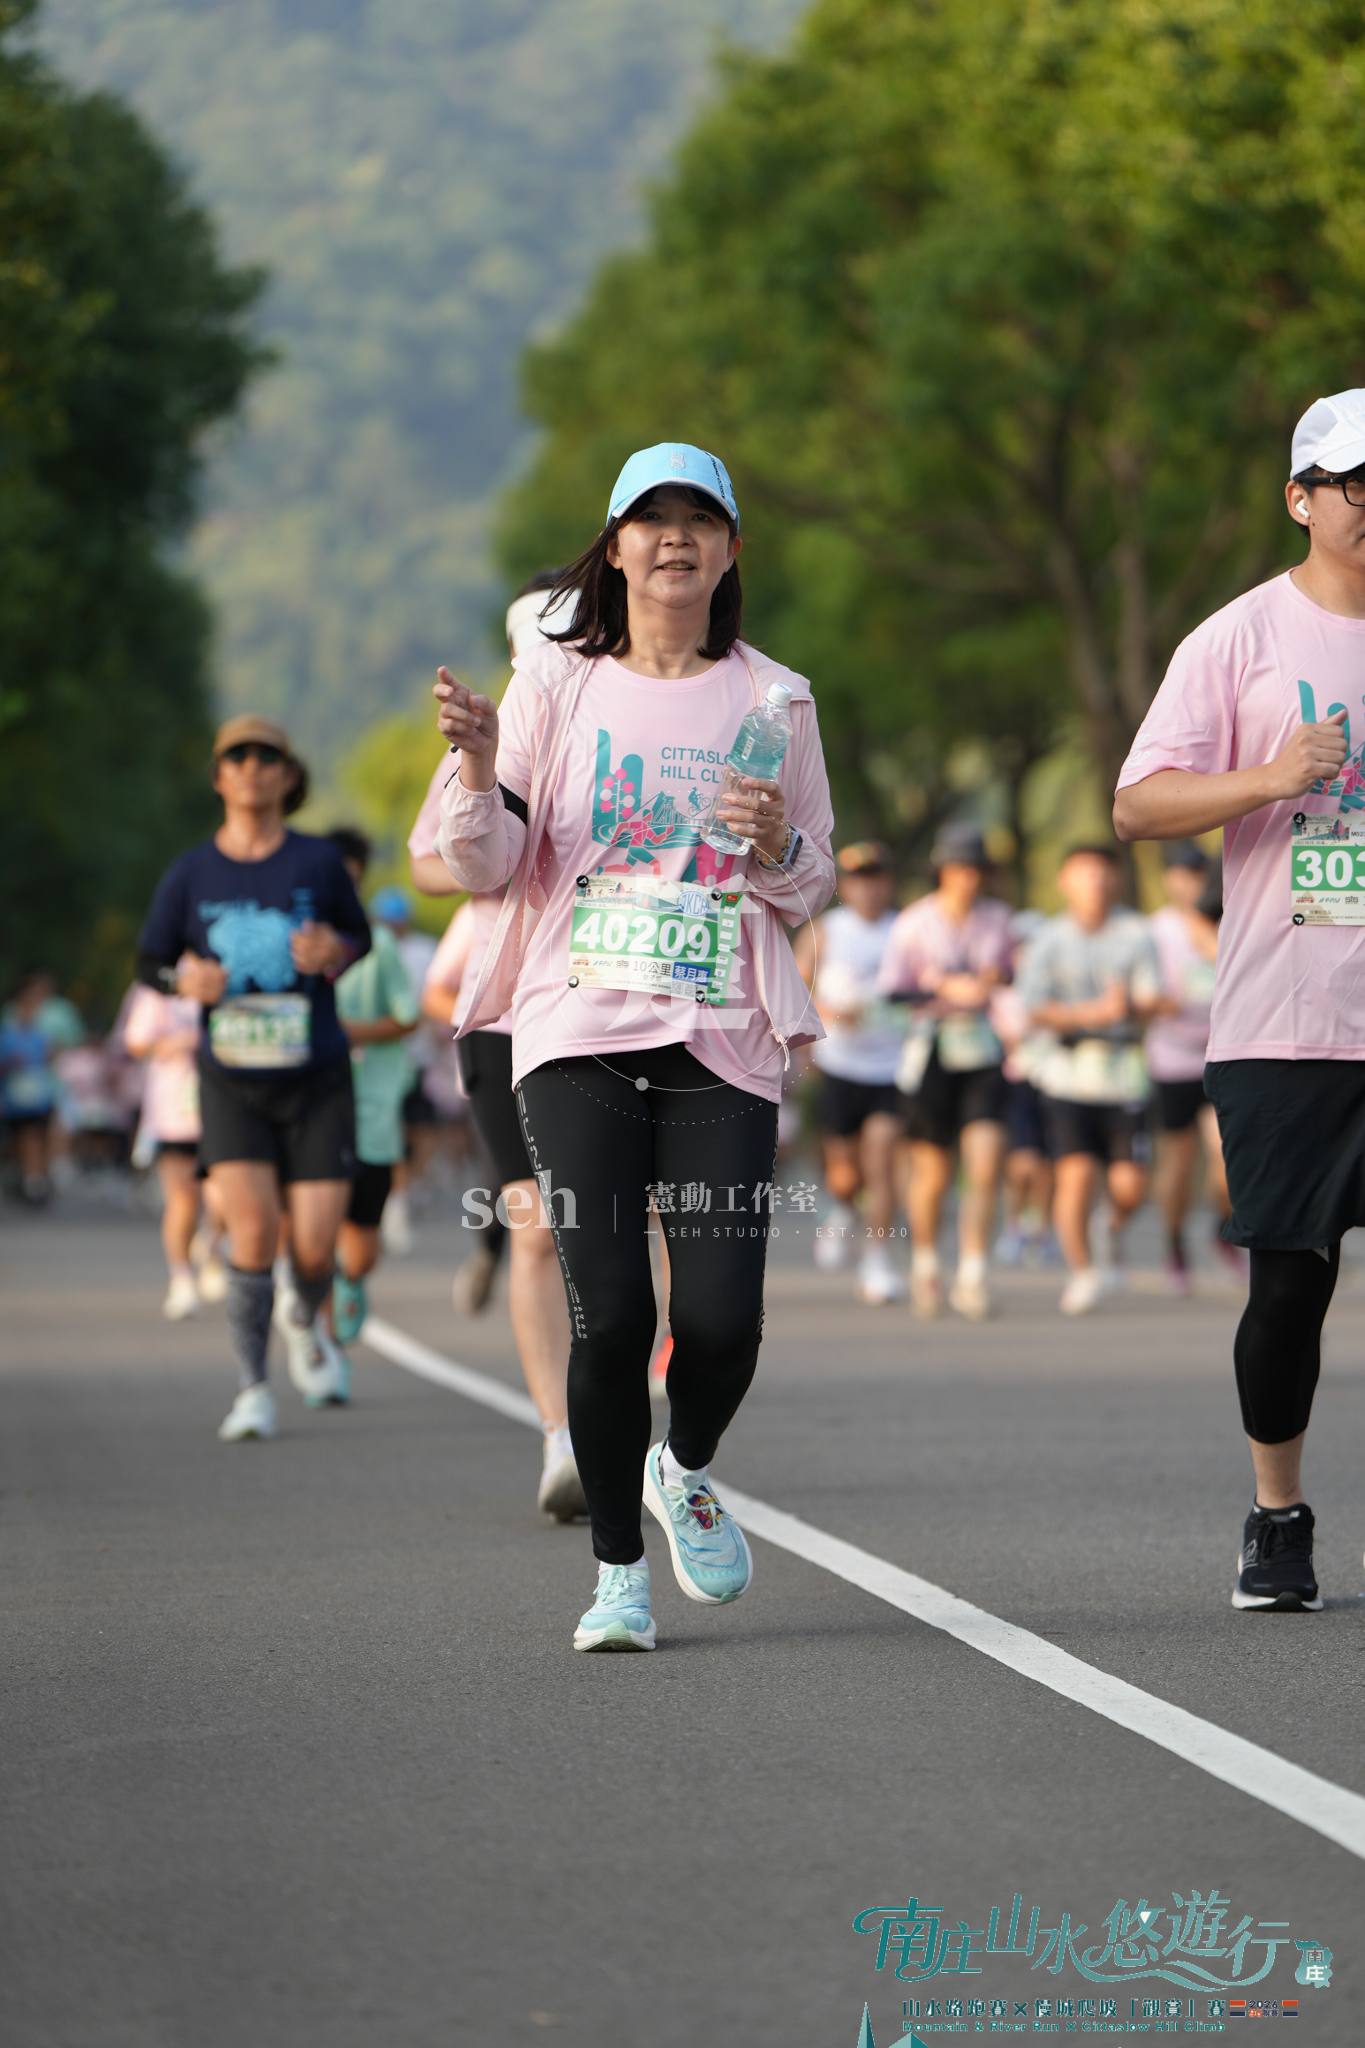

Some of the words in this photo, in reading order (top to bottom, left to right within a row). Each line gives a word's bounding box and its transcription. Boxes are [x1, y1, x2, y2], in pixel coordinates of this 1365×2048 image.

[660, 765, 696, 780] HILL
[700, 768, 724, 784] CL
[574, 912, 710, 963] 40209
